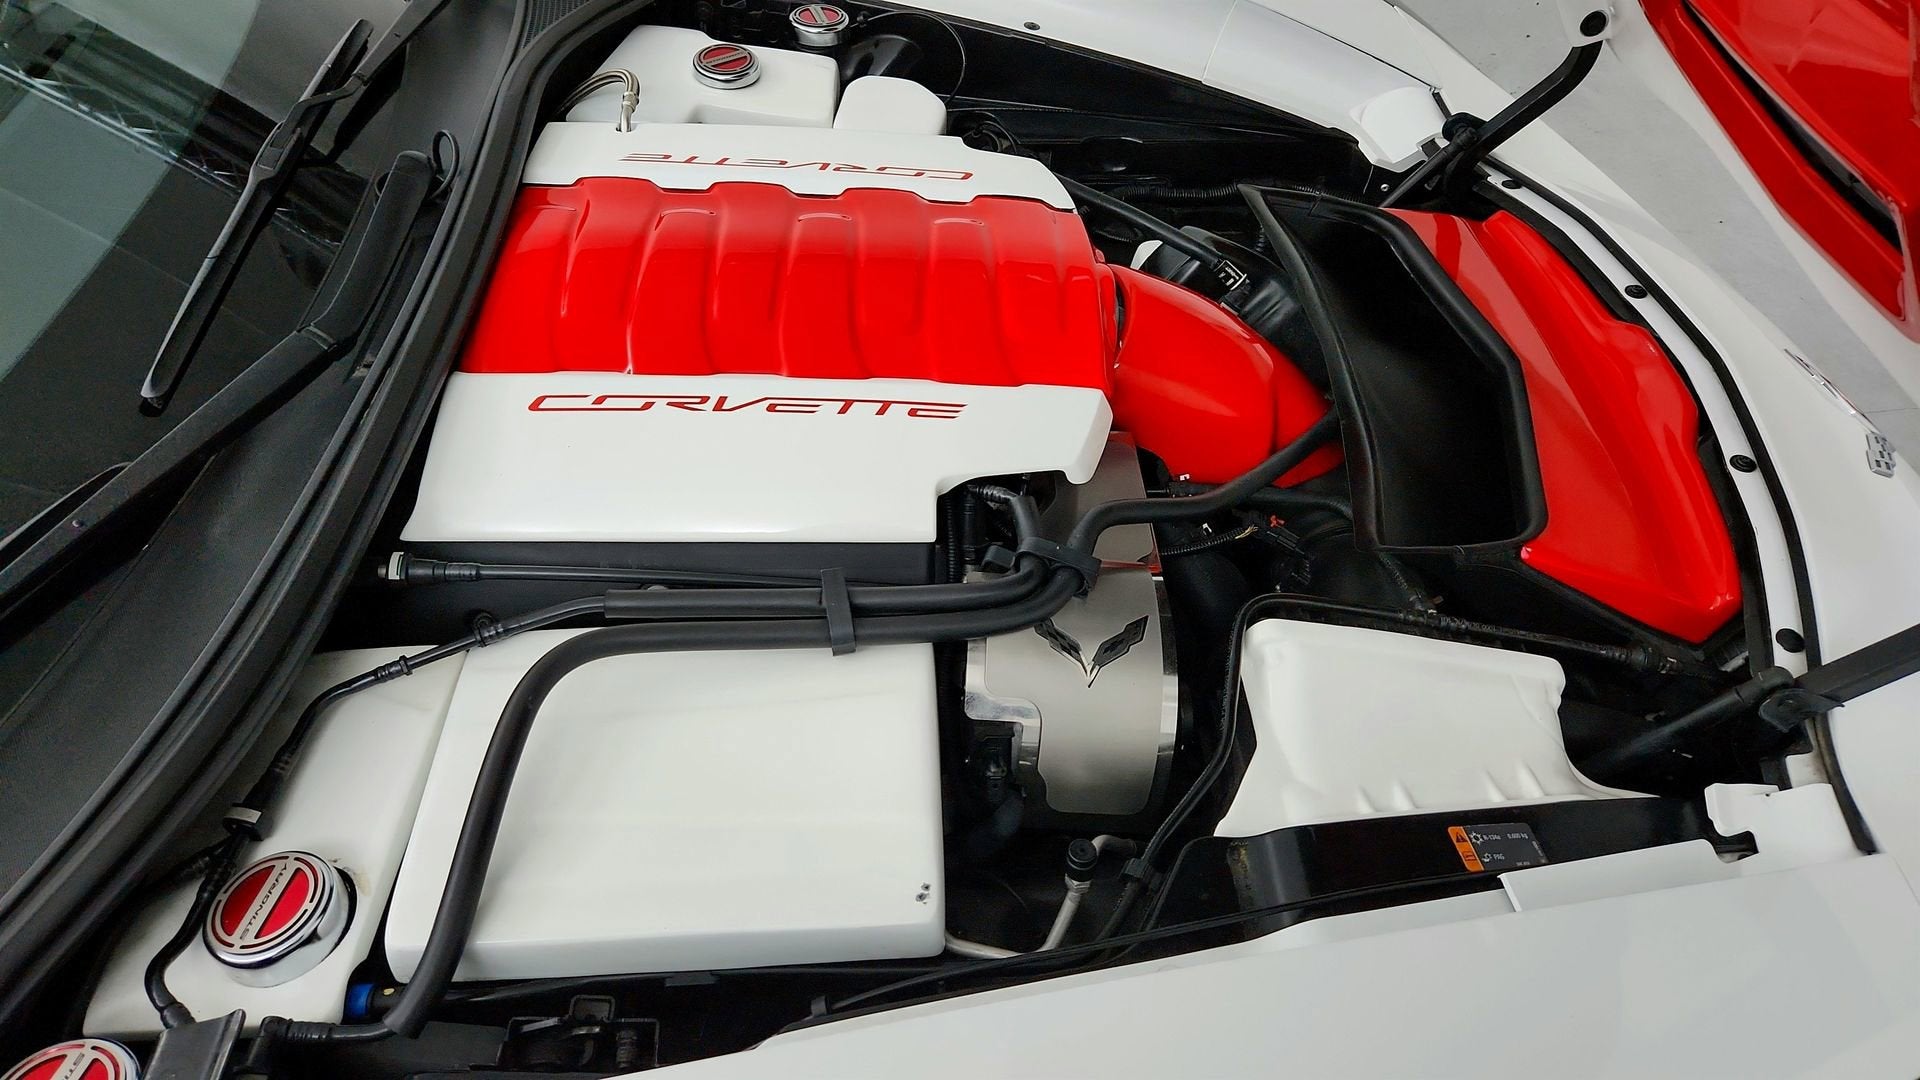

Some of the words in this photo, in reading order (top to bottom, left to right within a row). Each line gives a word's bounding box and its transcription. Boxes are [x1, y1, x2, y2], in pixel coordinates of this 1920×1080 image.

[619, 152, 974, 181] CORVETTE
[528, 394, 968, 419] CORVETTE
[240, 862, 287, 940] STINGRAY
